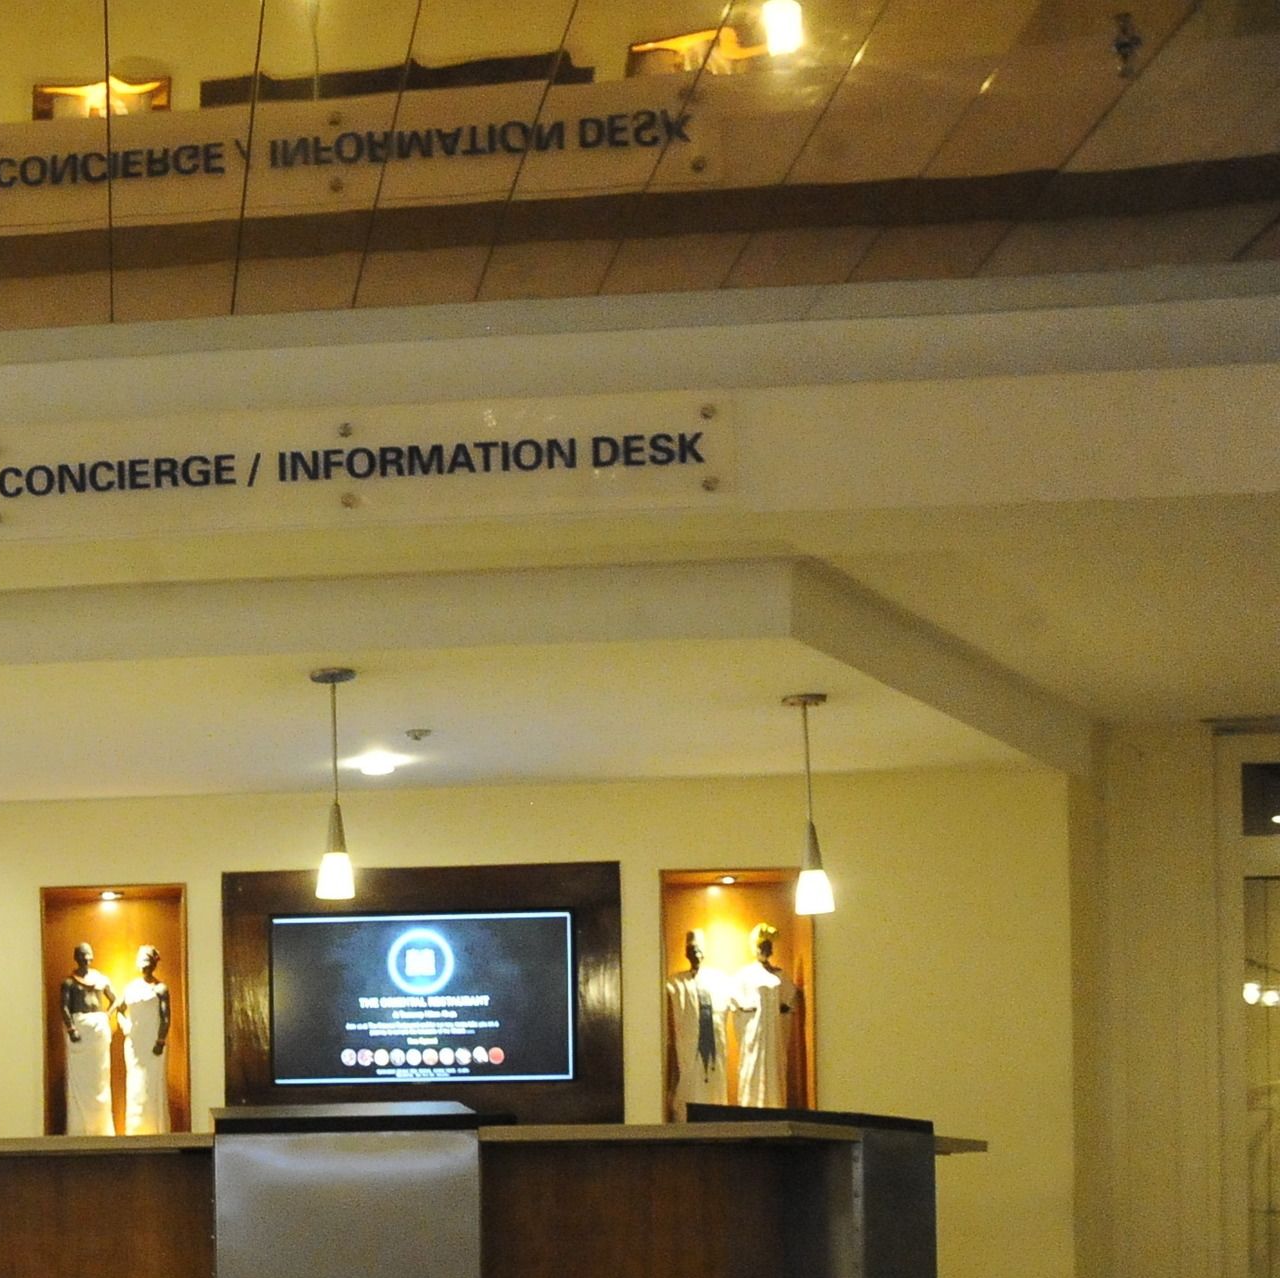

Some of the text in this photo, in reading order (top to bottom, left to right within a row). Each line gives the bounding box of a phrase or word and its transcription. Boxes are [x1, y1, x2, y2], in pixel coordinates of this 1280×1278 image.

[247, 452, 261, 488] /
[278, 438, 576, 482] INFORMATION
[590, 431, 705, 468] DESK
